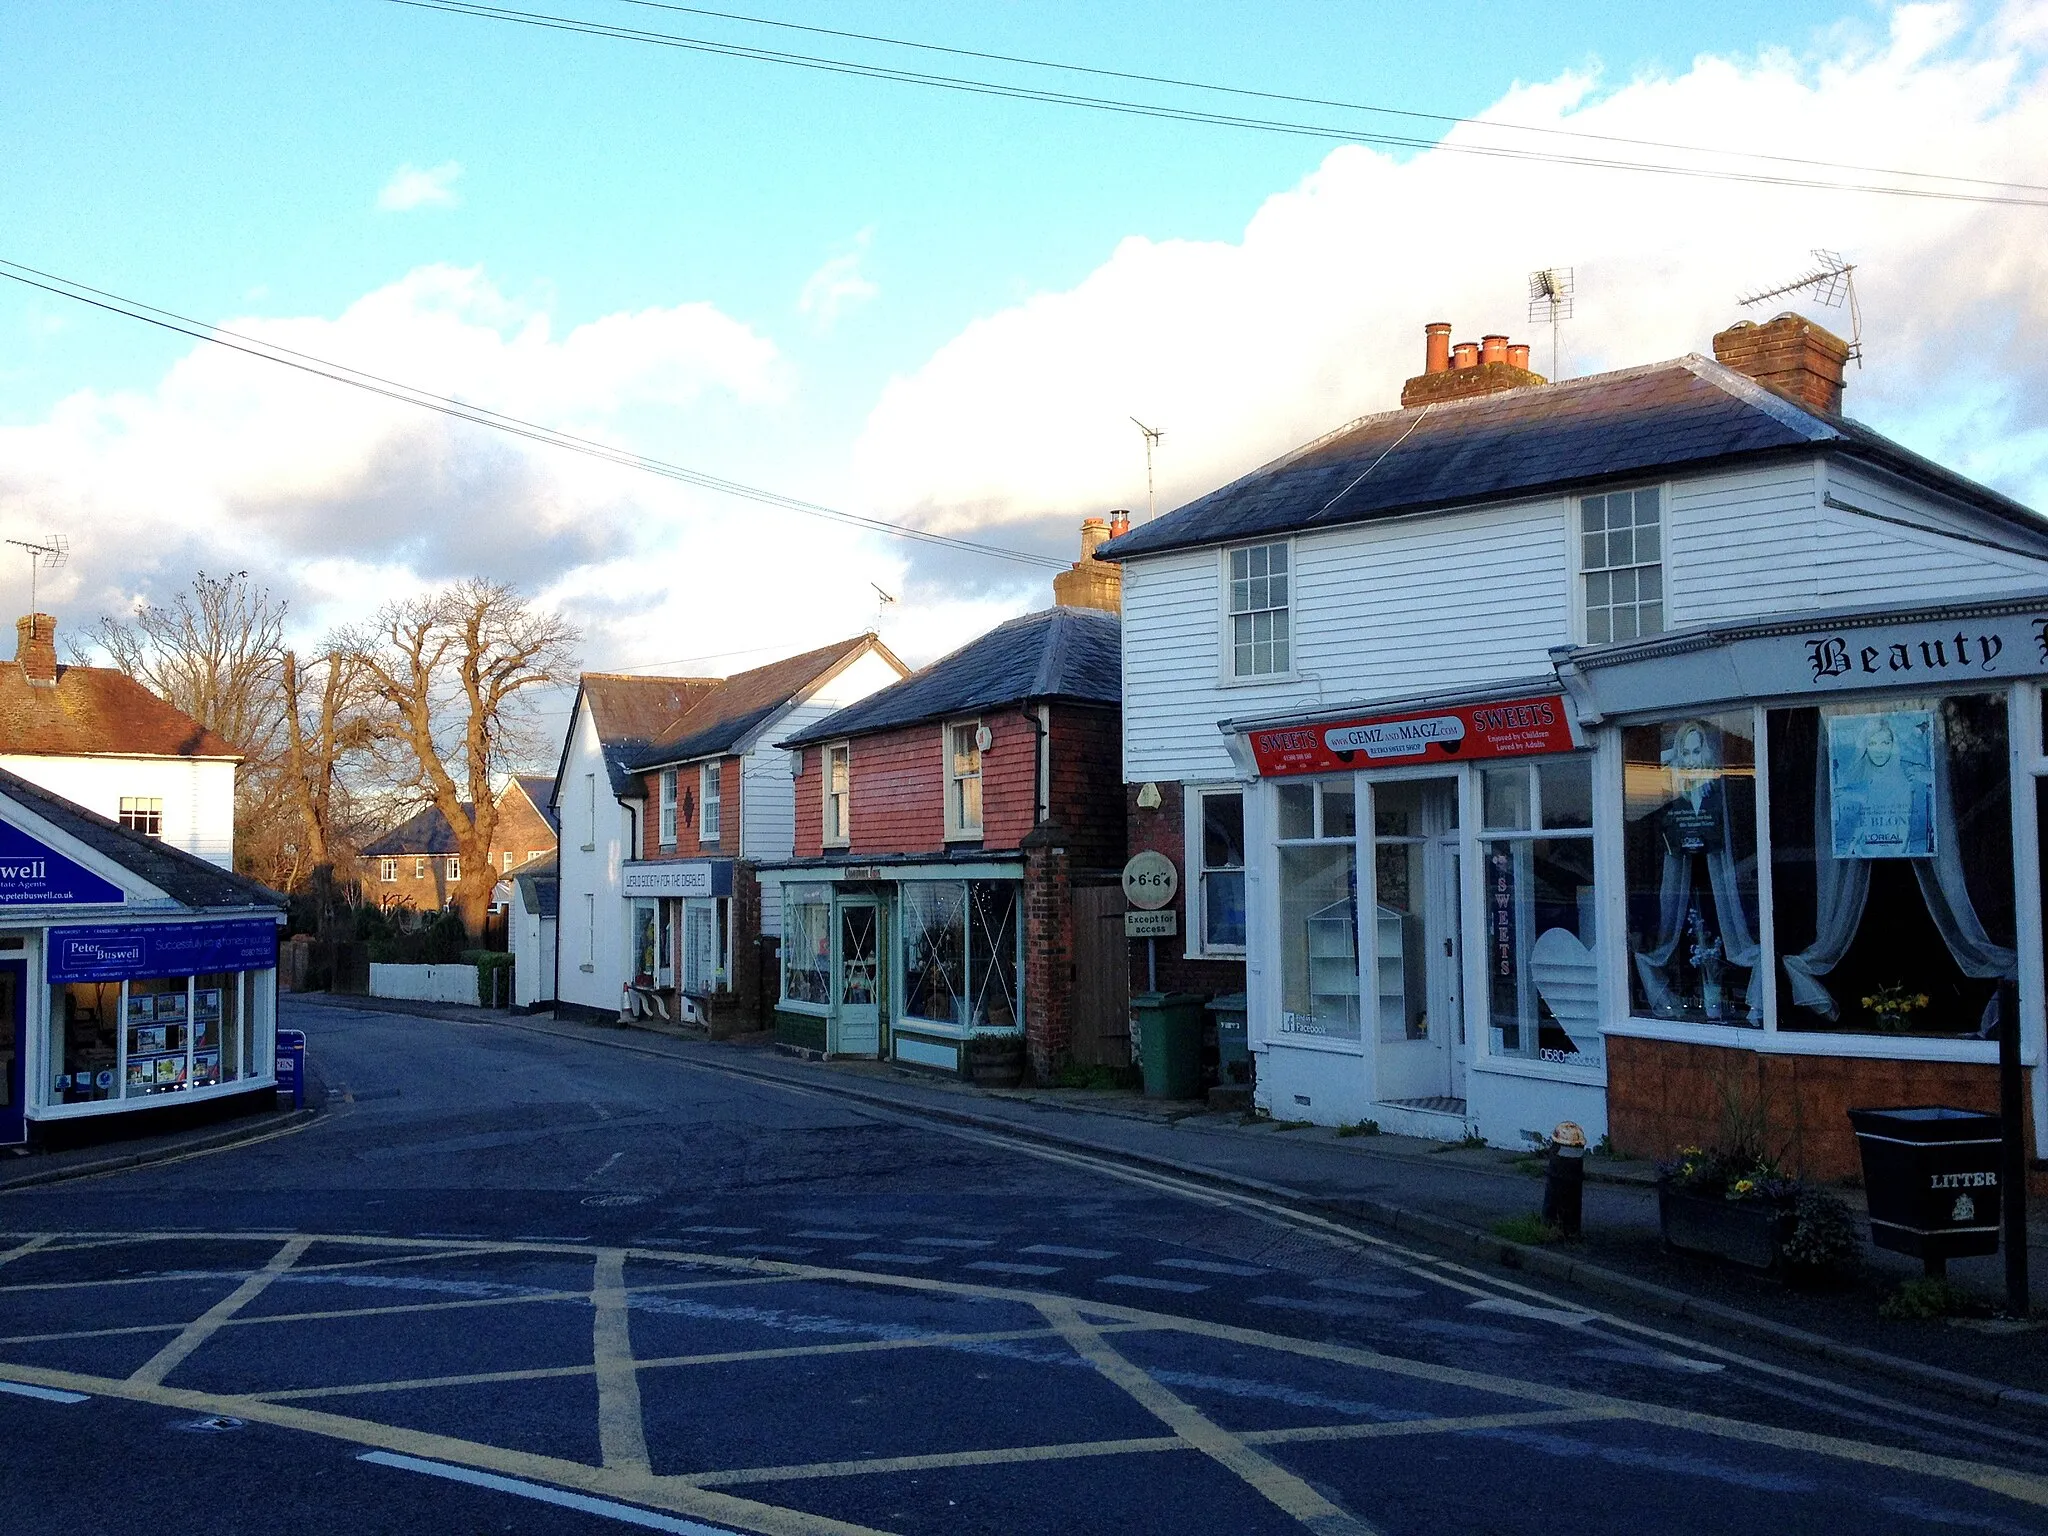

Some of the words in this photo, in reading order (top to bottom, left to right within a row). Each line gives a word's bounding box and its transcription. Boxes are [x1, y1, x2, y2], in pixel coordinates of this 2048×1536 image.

[1804, 631, 2003, 684] Beauty
[1472, 703, 1555, 732] SWEETS
[1259, 730, 1318, 754] SWEETS
[1348, 729, 1383, 745] GEMZ
[1487, 733, 1512, 744] Enjoyed
[1512, 732, 1521, 742] by
[1521, 730, 1549, 740] Children
[1388, 744, 1406, 753] SWEET
[1406, 743, 1421, 751] SHOP
[1496, 742, 1515, 752] Loved
[1515, 741, 1523, 750] by
[1525, 740, 1545, 749] Adults
[18, 881, 46, 890] Agents
[1128, 915, 1159, 924] Except
[1160, 914, 1174, 923] for
[1494, 877, 1511, 976] SWEETS
[71, 942, 101, 953] Peter
[155, 936, 202, 950] Successfully
[97, 948, 139, 960] Buswell
[1296, 1022, 1327, 1034] Facebook
[1931, 1172, 1997, 1189] LITTER
